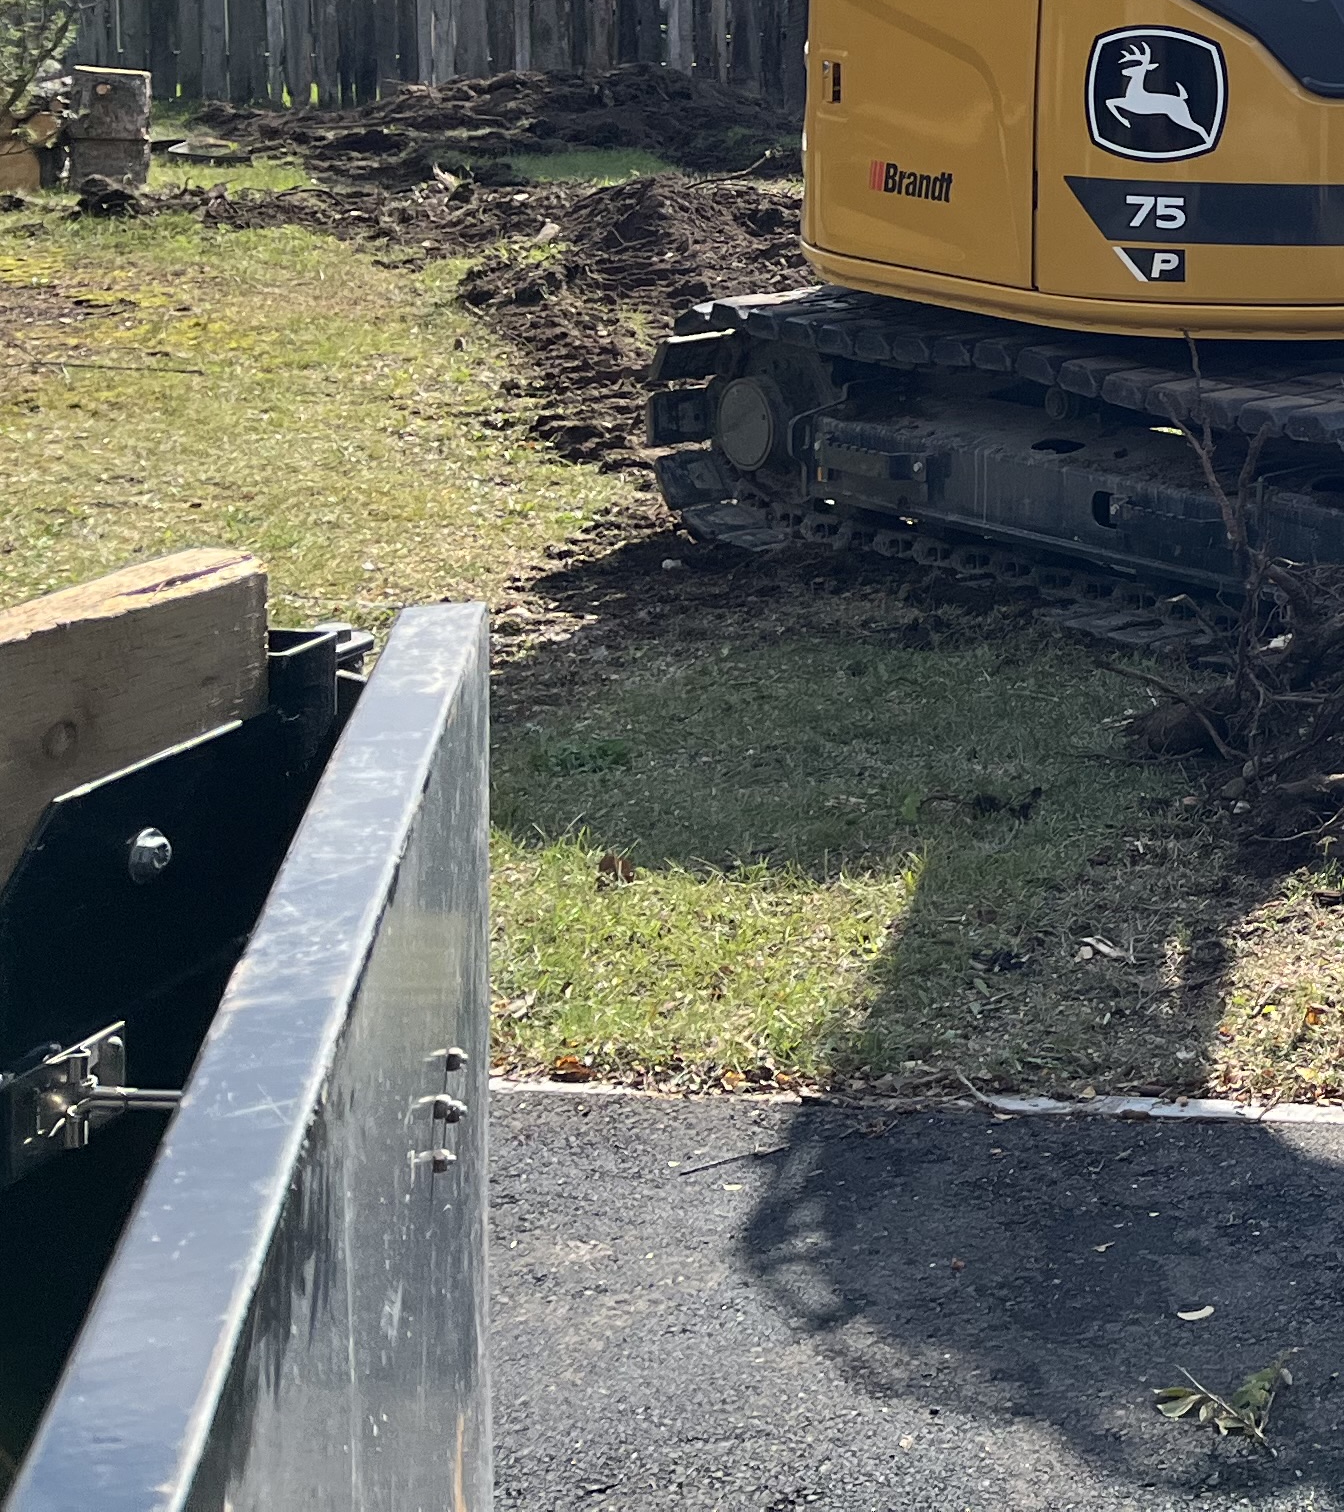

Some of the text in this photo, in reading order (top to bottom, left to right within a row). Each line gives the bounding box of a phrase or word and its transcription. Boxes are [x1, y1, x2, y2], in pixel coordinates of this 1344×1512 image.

[884, 162, 953, 203] Brandt
[1125, 195, 1186, 229] 75
[1150, 252, 1179, 278] P
